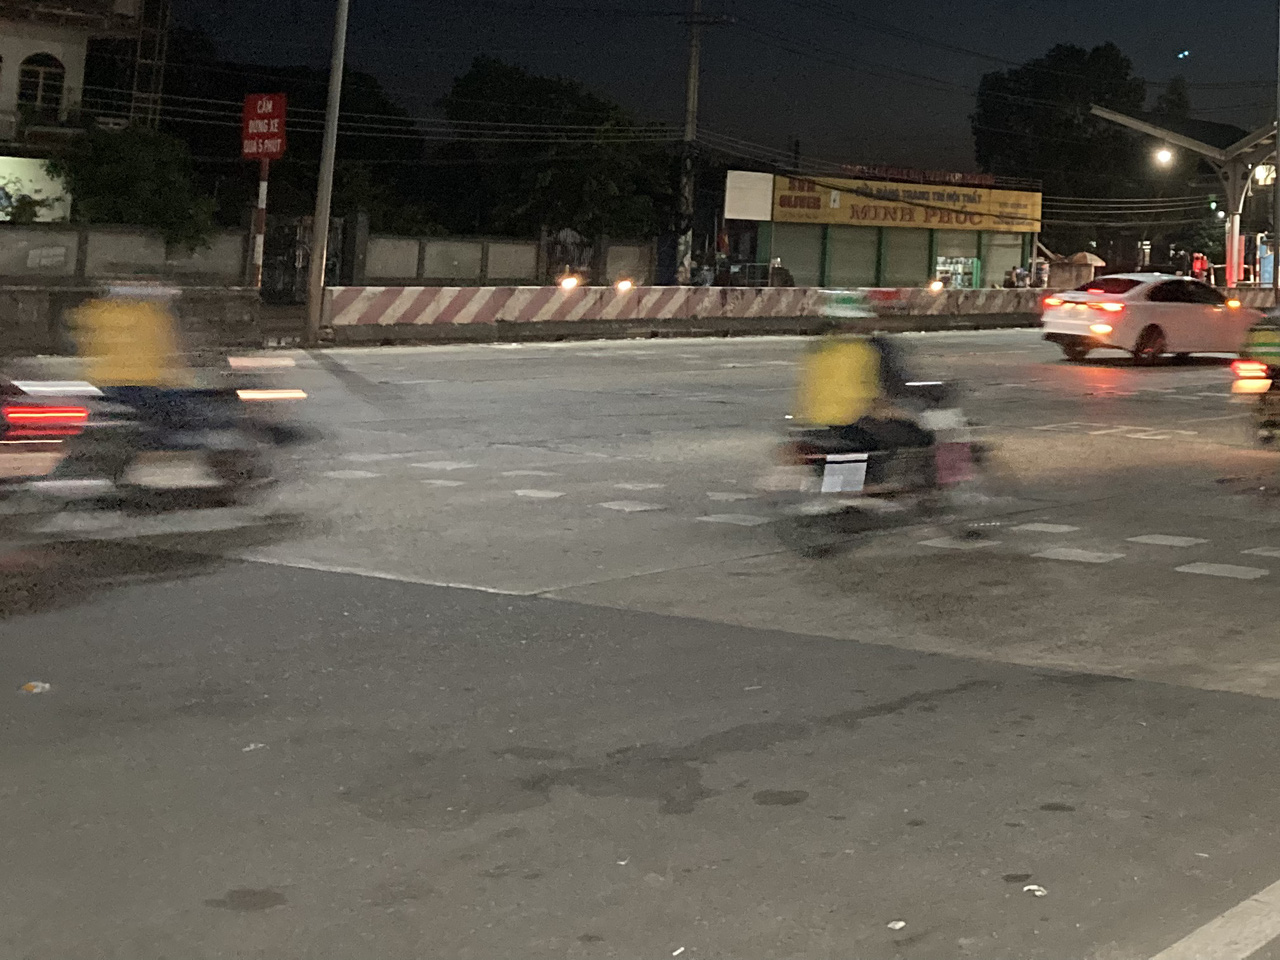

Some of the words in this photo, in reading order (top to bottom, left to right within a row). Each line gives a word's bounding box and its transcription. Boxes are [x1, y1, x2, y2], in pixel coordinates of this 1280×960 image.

[269, 118, 280, 132] XE
[902, 190, 931, 202] TRANG
[850, 204, 916, 223] MINH
[923, 205, 983, 226] PHÚC
